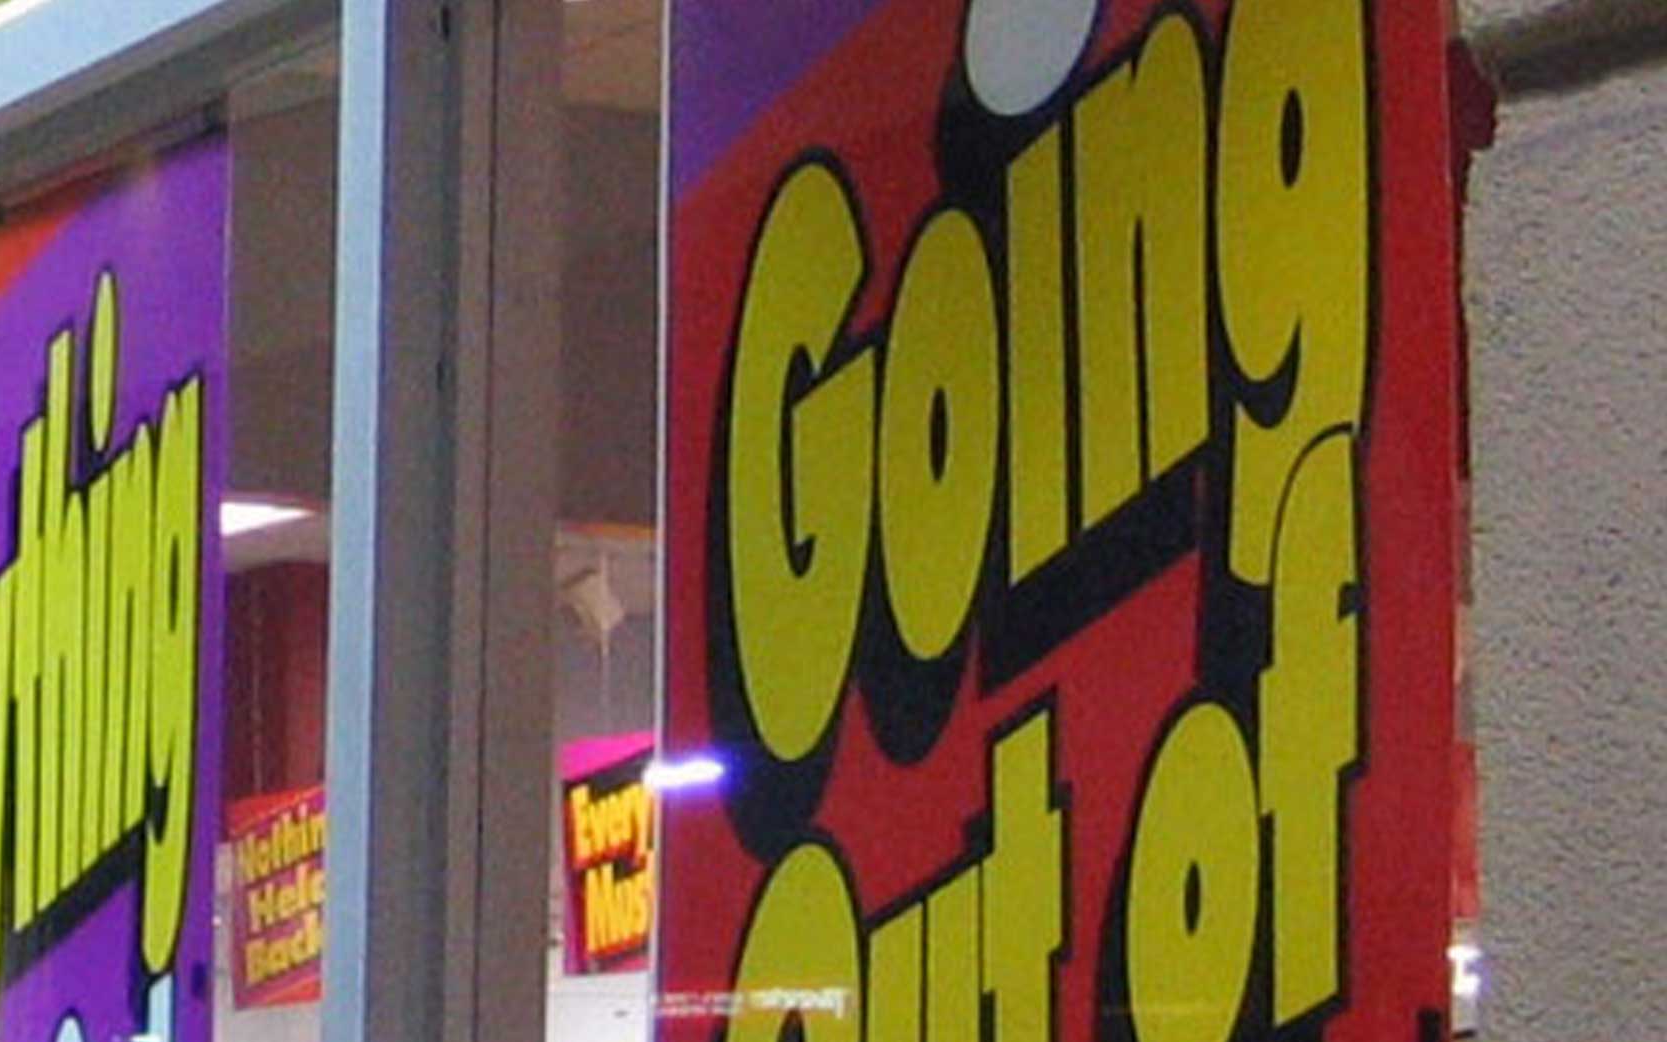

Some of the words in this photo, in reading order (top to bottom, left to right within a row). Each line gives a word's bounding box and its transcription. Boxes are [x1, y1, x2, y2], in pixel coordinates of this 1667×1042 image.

[727, 0, 1371, 763] Going
[235, 803, 325, 884] Nothin
[569, 780, 654, 870] Every
[587, 858, 654, 952] Mus
